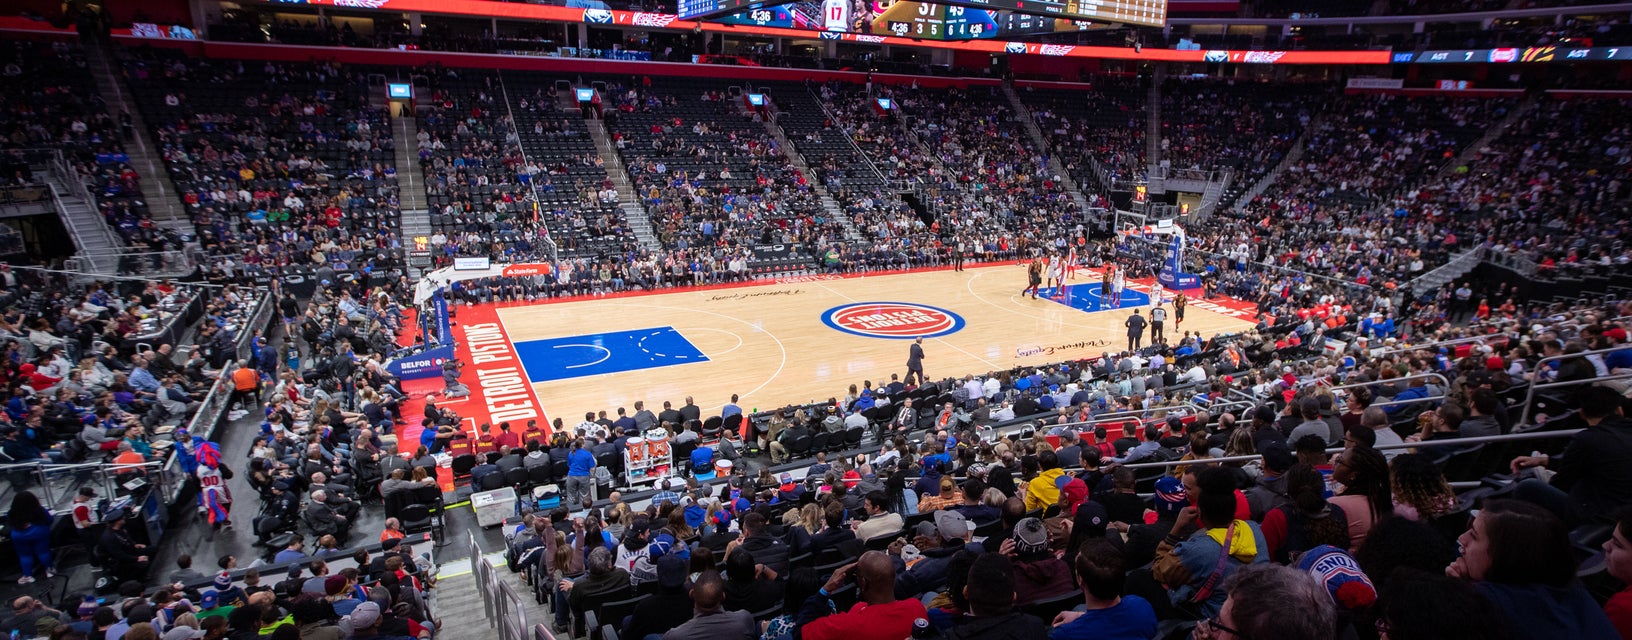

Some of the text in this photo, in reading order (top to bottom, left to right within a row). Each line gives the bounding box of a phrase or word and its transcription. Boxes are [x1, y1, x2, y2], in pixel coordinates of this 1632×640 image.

[751, 10, 771, 21] 4:36
[831, 7, 842, 21] 17
[891, 22, 909, 33] 4:36
[917, 23, 923, 34] 3
[931, 24, 937, 35] 5
[948, 25, 954, 35] 6
[959, 24, 965, 34] 4
[969, 24, 983, 34] 4:36
[1464, 52, 1474, 61] 7
[1607, 49, 1618, 59] 7
[847, 309, 928, 323] PISTONS
[861, 314, 940, 330] DETROIT
[401, 359, 431, 369] BELFOR
[463, 322, 538, 425] DETROIT PISTONS
